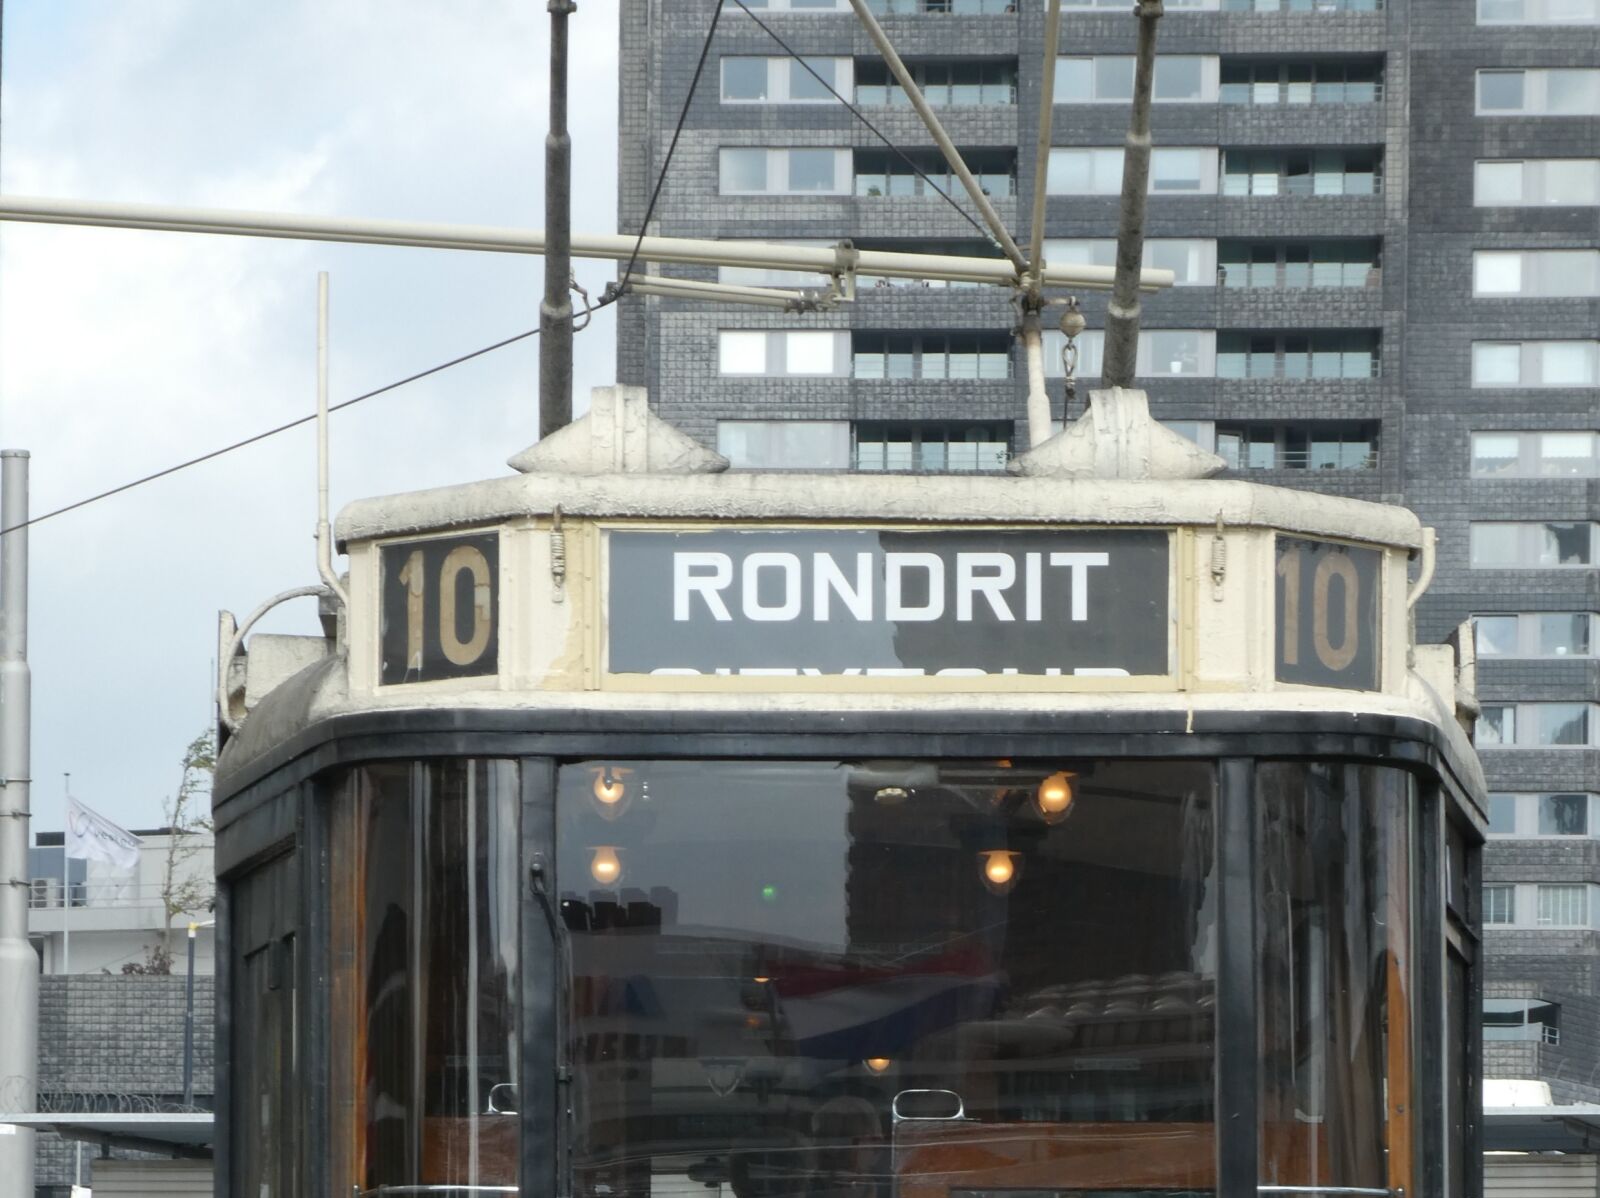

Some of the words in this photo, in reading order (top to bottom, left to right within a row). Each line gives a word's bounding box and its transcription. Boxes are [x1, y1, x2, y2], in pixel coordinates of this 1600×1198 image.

[399, 545, 491, 667] 10
[673, 552, 1109, 622] RONDRIT
[1276, 551, 1359, 671] 10
